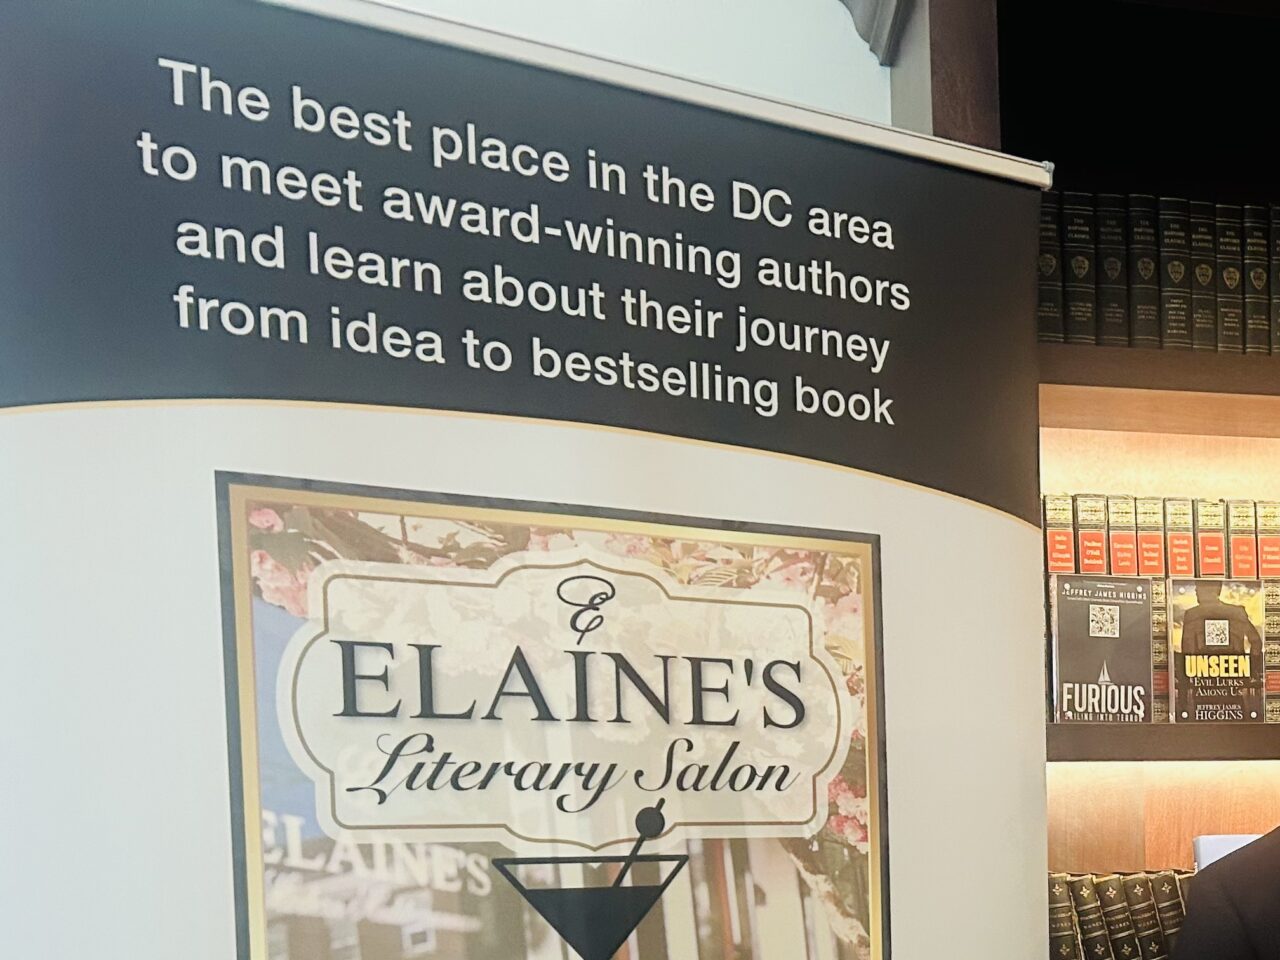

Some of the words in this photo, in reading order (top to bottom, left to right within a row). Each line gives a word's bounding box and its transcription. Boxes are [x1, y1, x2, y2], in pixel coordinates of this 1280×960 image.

[159, 58, 269, 121] The
[293, 86, 412, 151] best
[433, 124, 569, 181] place
[589, 150, 625, 194] in
[643, 165, 714, 211] the
[733, 181, 792, 227] DC
[809, 208, 894, 249] area
[137, 132, 196, 180] to
[222, 156, 362, 211] meet
[384, 185, 741, 287] award-winning
[759, 258, 909, 310] authors
[177, 223, 284, 268] and
[309, 232, 441, 294] learn
[464, 265, 605, 319] about
[621, 289, 722, 337] their
[737, 316, 889, 373] journey
[174, 285, 307, 343] from
[332, 307, 445, 363] idea
[462, 330, 512, 371] to
[533, 344, 778, 416] bestselling
[796, 376, 894, 424] book
[330, 639, 806, 729] ELAINE'S
[1063, 683, 1145, 713] FURIOUS
[1185, 655, 1250, 677] UNSEEN
[1196, 711, 1243, 719] HIGGINS
[346, 732, 627, 813] Literary
[634, 737, 797, 791] Salon
